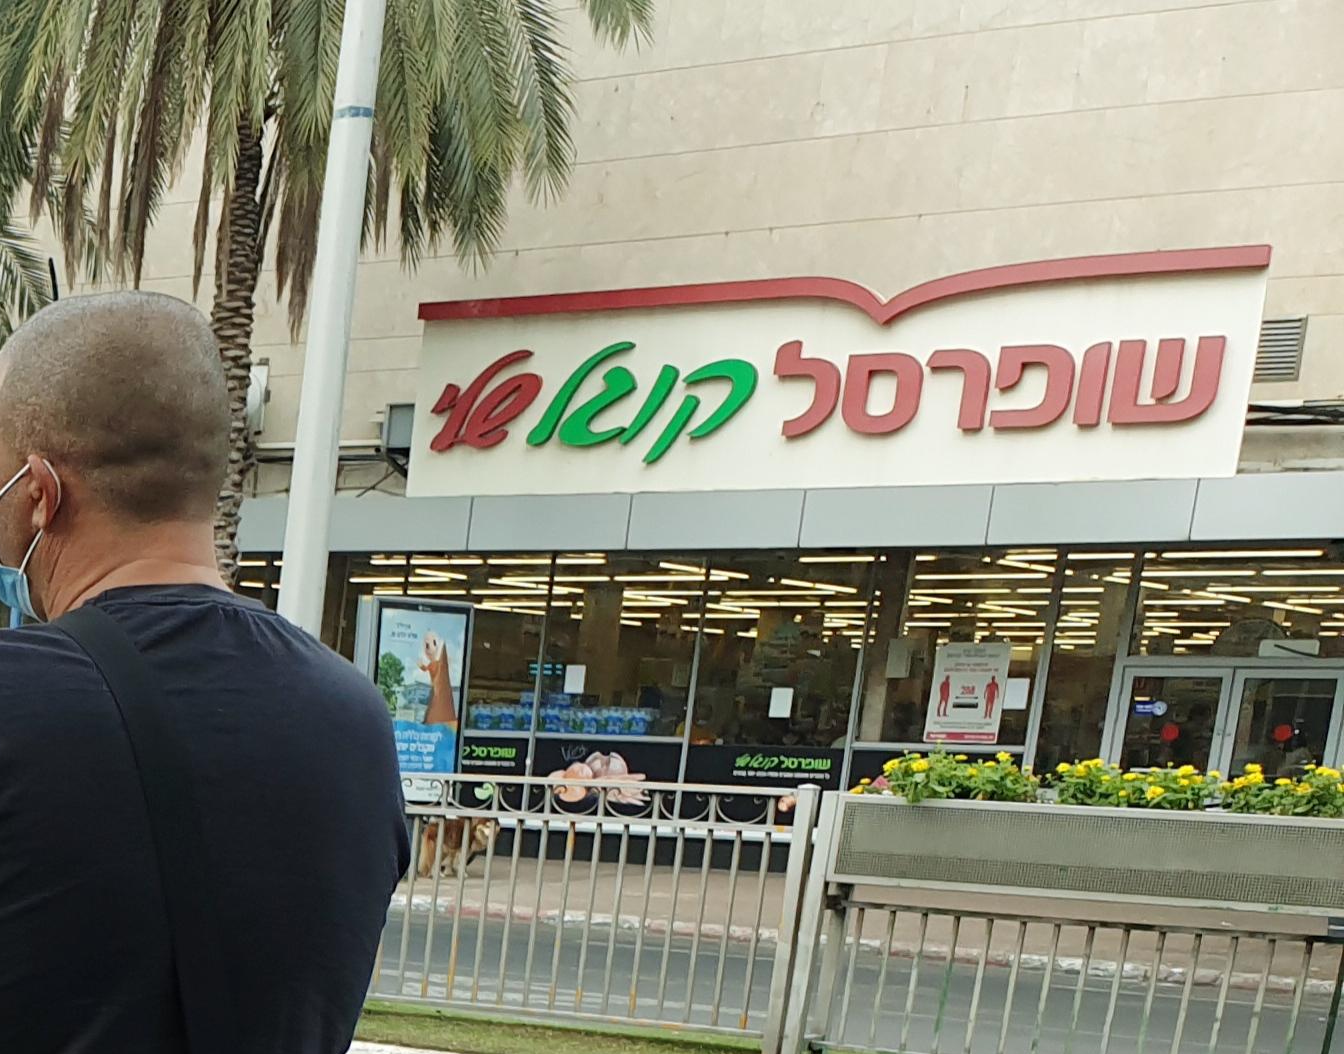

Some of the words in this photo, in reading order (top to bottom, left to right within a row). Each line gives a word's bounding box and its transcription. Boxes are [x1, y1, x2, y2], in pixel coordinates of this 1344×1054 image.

[429, 349, 544, 451] שלי
[773, 335, 1227, 439] שופרסל
[471, 744, 516, 759] שופרסל
[779, 755, 831, 770] שופרסל
